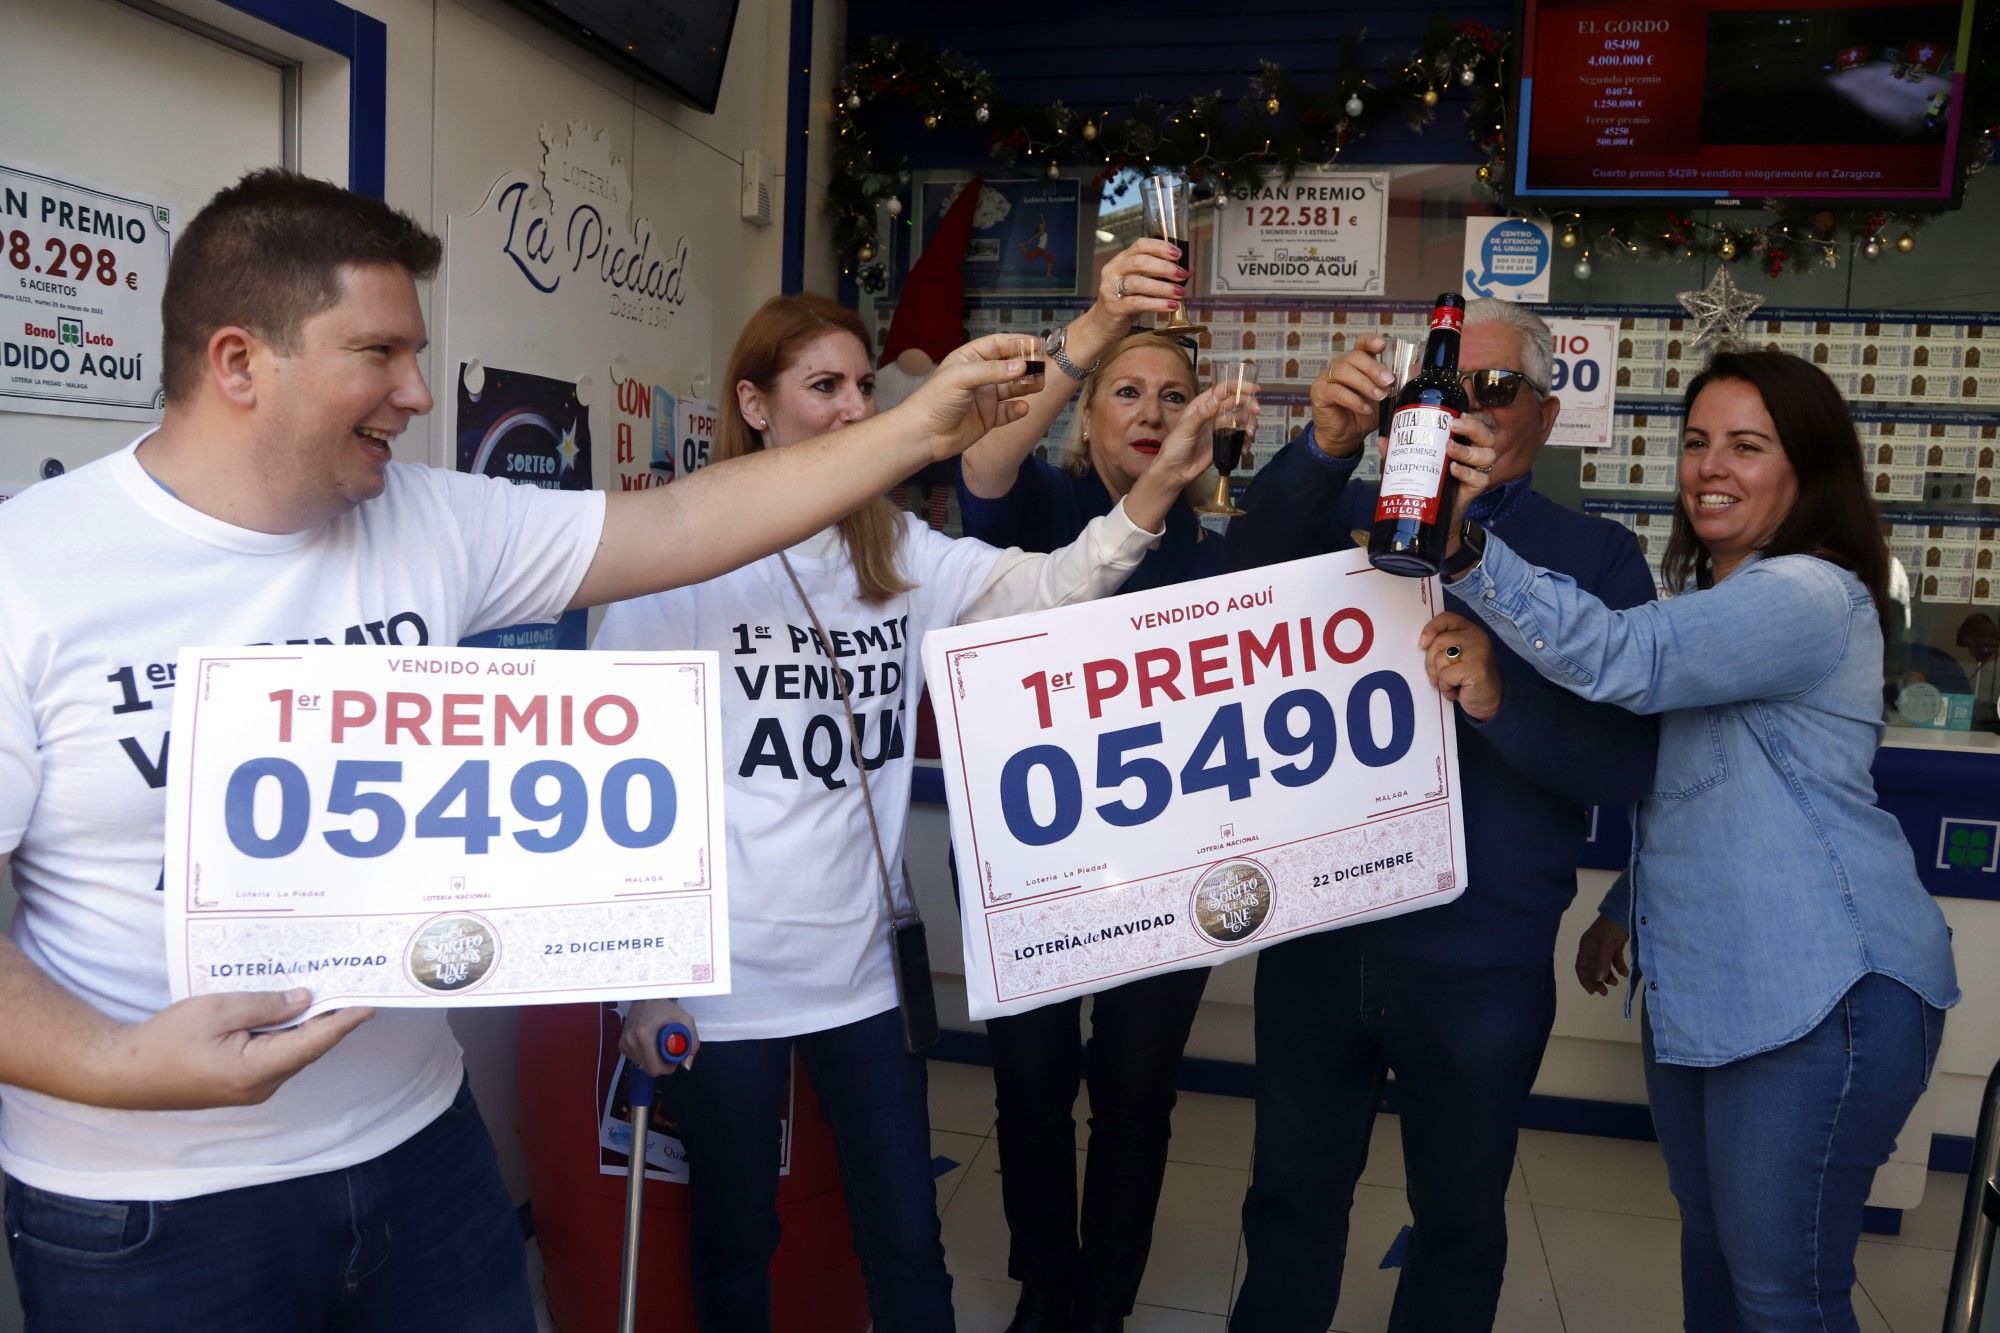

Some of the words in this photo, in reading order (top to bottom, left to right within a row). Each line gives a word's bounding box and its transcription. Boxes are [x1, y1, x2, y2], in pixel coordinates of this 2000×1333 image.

[1577, 20, 1600, 34] EL
[1604, 19, 1670, 34] GORDO
[1604, 39, 1640, 50] 05490
[1588, 55, 1644, 66] 4.000.000
[1647, 54, 1656, 66] €
[1579, 75, 1622, 86] Segundo
[1624, 74, 1662, 85] premio
[1585, 116, 1616, 124] Tercer
[1617, 115, 1651, 125] premio
[1592, 168, 1627, 178] Cuarto
[1629, 168, 1665, 180] premio
[1668, 168, 1698, 178] 54289
[1700, 169, 1742, 179] vendido
[1816, 171, 1829, 179] en
[1236, 186, 1289, 201] GRAN
[1296, 186, 1366, 201] PREMIO
[41, 195, 146, 244] PREMIO
[1246, 206, 1341, 226] 122.581
[1349, 215, 1358, 226] €
[498, 182, 560, 294] La
[567, 205, 688, 306] Piedad
[0, 228, 118, 287] 8.298
[125, 271, 138, 291] €
[1237, 262, 1309, 276] VENDIDO
[1315, 260, 1358, 277] AQUÍ
[20, 277, 27, 288] 6
[29, 279, 77, 297] ACIERTOS
[24, 322, 56, 340] Bono
[85, 331, 114, 347] Loto
[0, 341, 70, 373] DIDO
[79, 352, 143, 381] AQUÍ
[618, 378, 651, 419] CON
[617, 423, 636, 464] EL
[507, 453, 556, 475] SORTEO
[1384, 462, 1440, 475] Quitapenas
[1382, 499, 1428, 508] MALAGA
[1385, 506, 1421, 515] DULCE
[1131, 600, 1220, 632] VENDIDO
[1226, 585, 1274, 611] AQUÍ
[732, 623, 772, 655] 1er
[387, 658, 480, 675] VENDIDO
[486, 659, 536, 676] AQUÍ
[1021, 667, 1075, 729] 1er
[1082, 607, 1374, 719] PREMIO
[734, 661, 905, 701] VENDID
[268, 688, 321, 743] 1er
[331, 690, 640, 746] PREMIO
[1000, 670, 1415, 847] 05490
[1375, 790, 1409, 803] MALAGA
[224, 757, 678, 859] 05490
[1225, 834, 1260, 848] NACIONAL
[625, 875, 665, 884] MALAGA
[1063, 870, 1074, 879] La
[1077, 862, 1108, 876] Piedad
[1312, 873, 1330, 888] 22
[1335, 852, 1415, 882] DICIEMBRE
[277, 889, 289, 898] La
[292, 889, 326, 898] Piedad
[454, 892, 492, 901] NACIONAL
[1207, 877, 1258, 912] SORTEO
[1217, 908, 1252, 933] UNE
[544, 943, 564, 956] 22
[570, 936, 666, 954] DICIEMBRE
[431, 962, 470, 984] UNE
